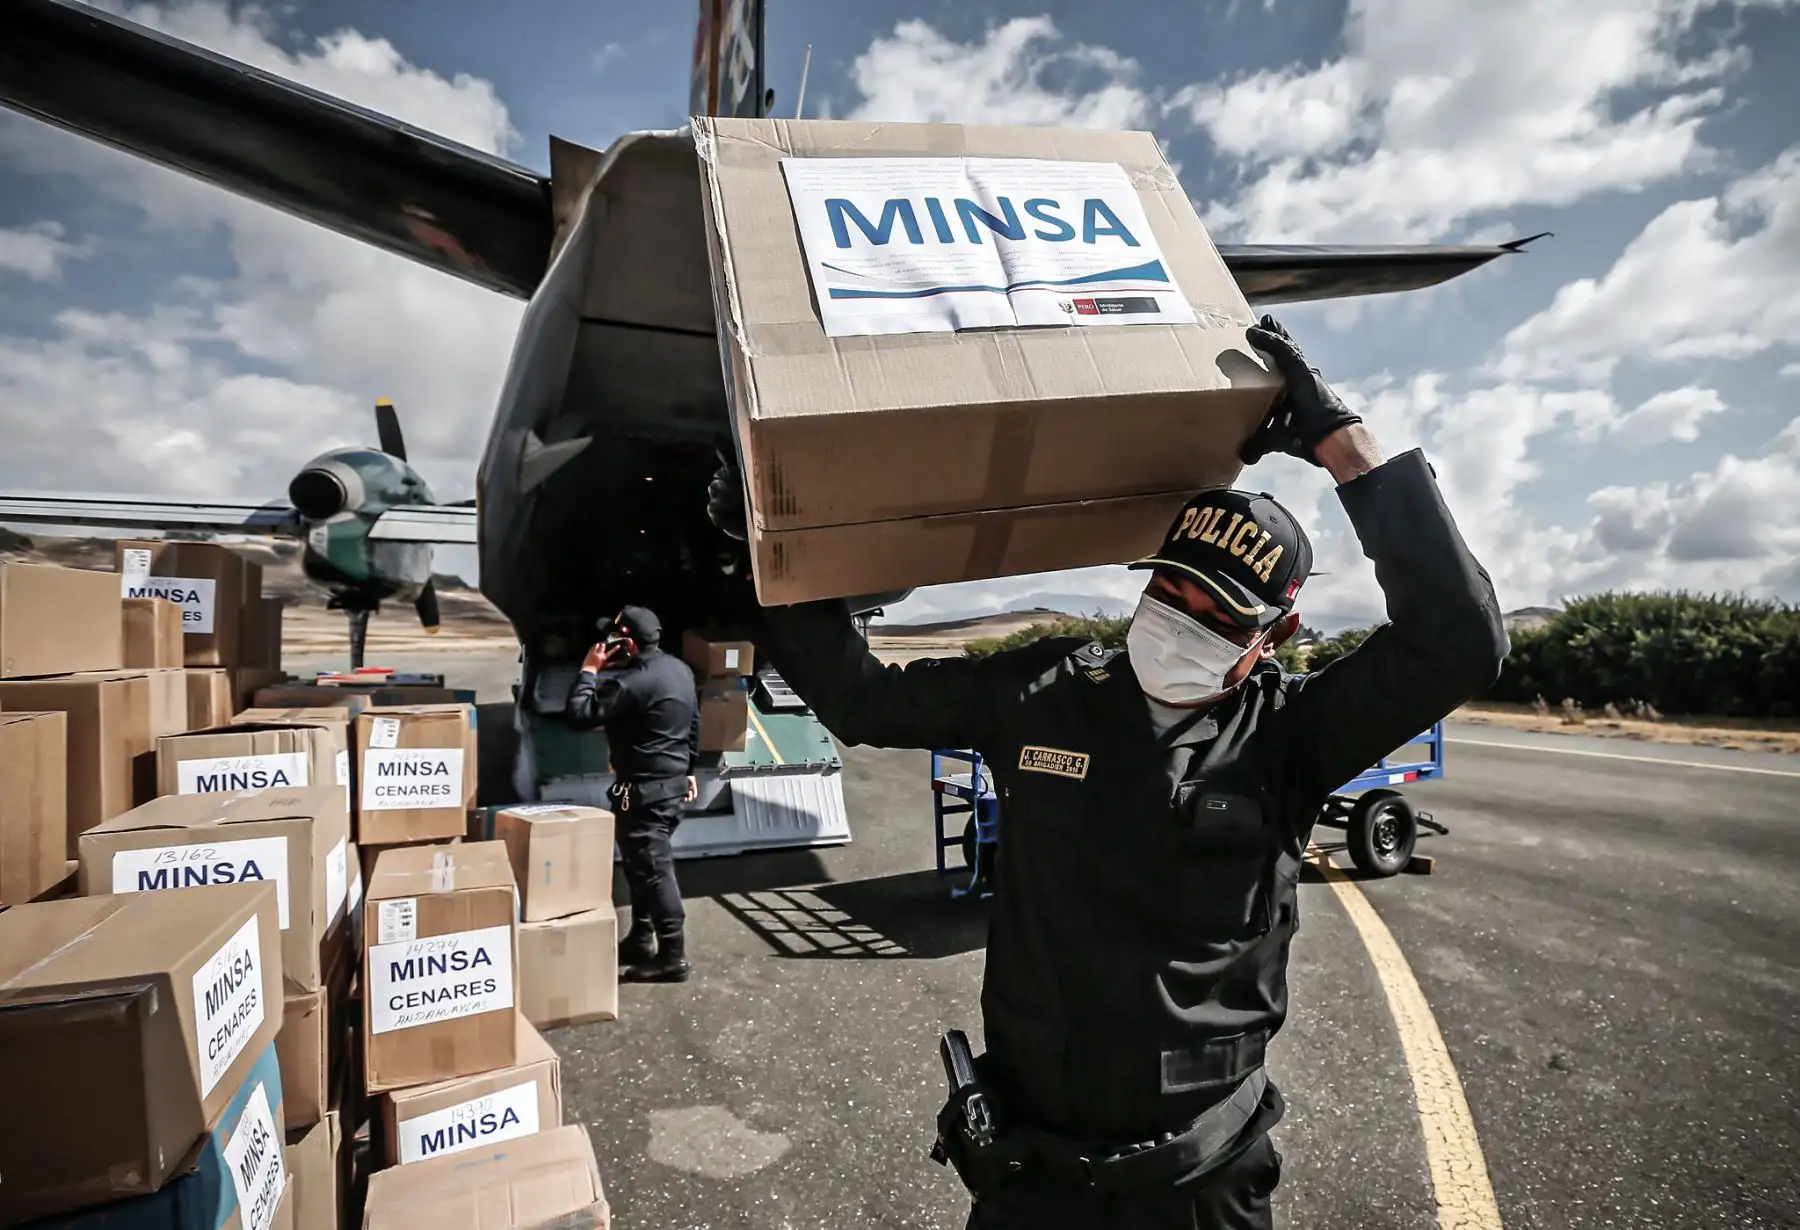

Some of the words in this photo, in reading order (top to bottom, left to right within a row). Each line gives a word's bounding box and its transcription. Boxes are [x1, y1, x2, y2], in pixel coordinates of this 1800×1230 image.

[825, 196, 1141, 249] MINSA
[1172, 506, 1284, 583] POLICIA
[128, 587, 201, 604] MINSA
[378, 761, 449, 777] MINSA
[1033, 751, 1073, 766] CARRASCO
[197, 769, 290, 793] MINSA
[375, 784, 451, 796] CENARES
[154, 849, 221, 864] 13162
[138, 860, 263, 891] MINSA
[390, 947, 493, 983] MINSA
[205, 949, 253, 1021] MINSA
[389, 978, 497, 1011] CENARES
[208, 988, 257, 1060] CENARES
[420, 1106, 520, 1155] MINSA
[240, 1118, 270, 1192] MINSA
